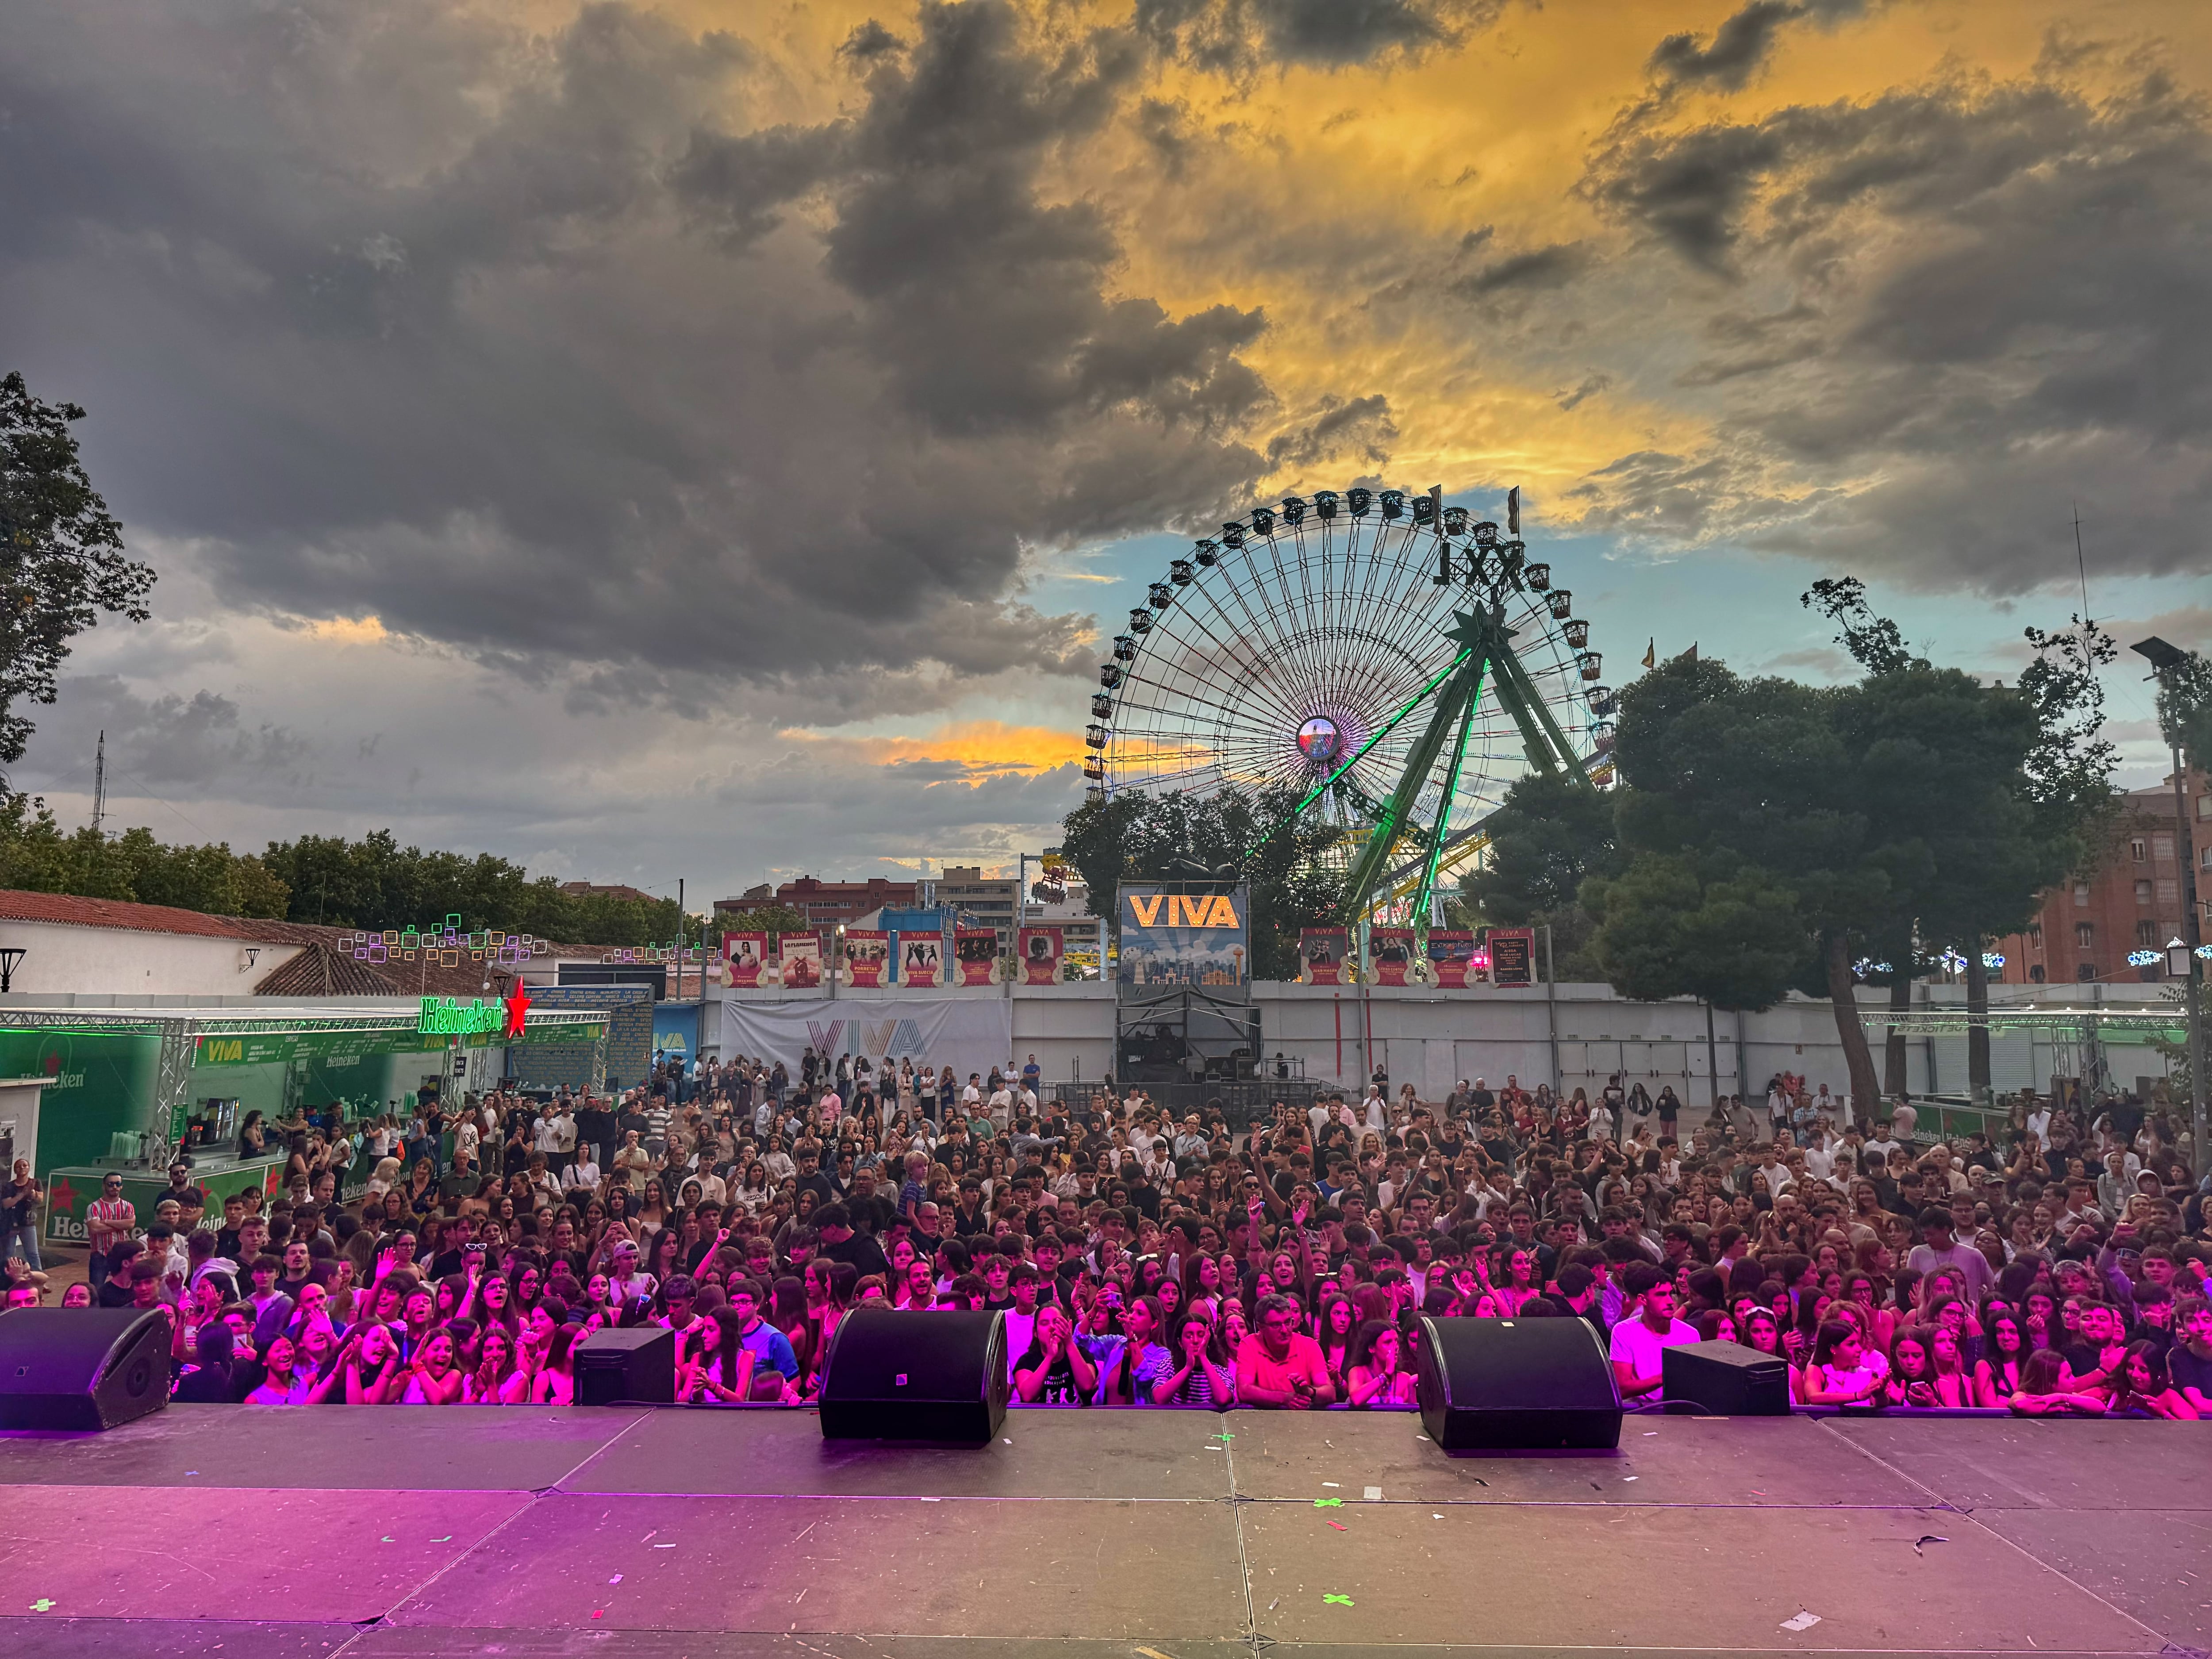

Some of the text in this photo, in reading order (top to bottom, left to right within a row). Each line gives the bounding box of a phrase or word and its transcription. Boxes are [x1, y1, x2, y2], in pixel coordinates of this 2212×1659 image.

[1129, 895, 1240, 929] VIVA
[418, 997, 503, 1034] Heineken
[209, 1040, 242, 1062] VIVA
[806, 1019, 927, 1056] VIVA
[326, 1055, 360, 1068] Heineken
